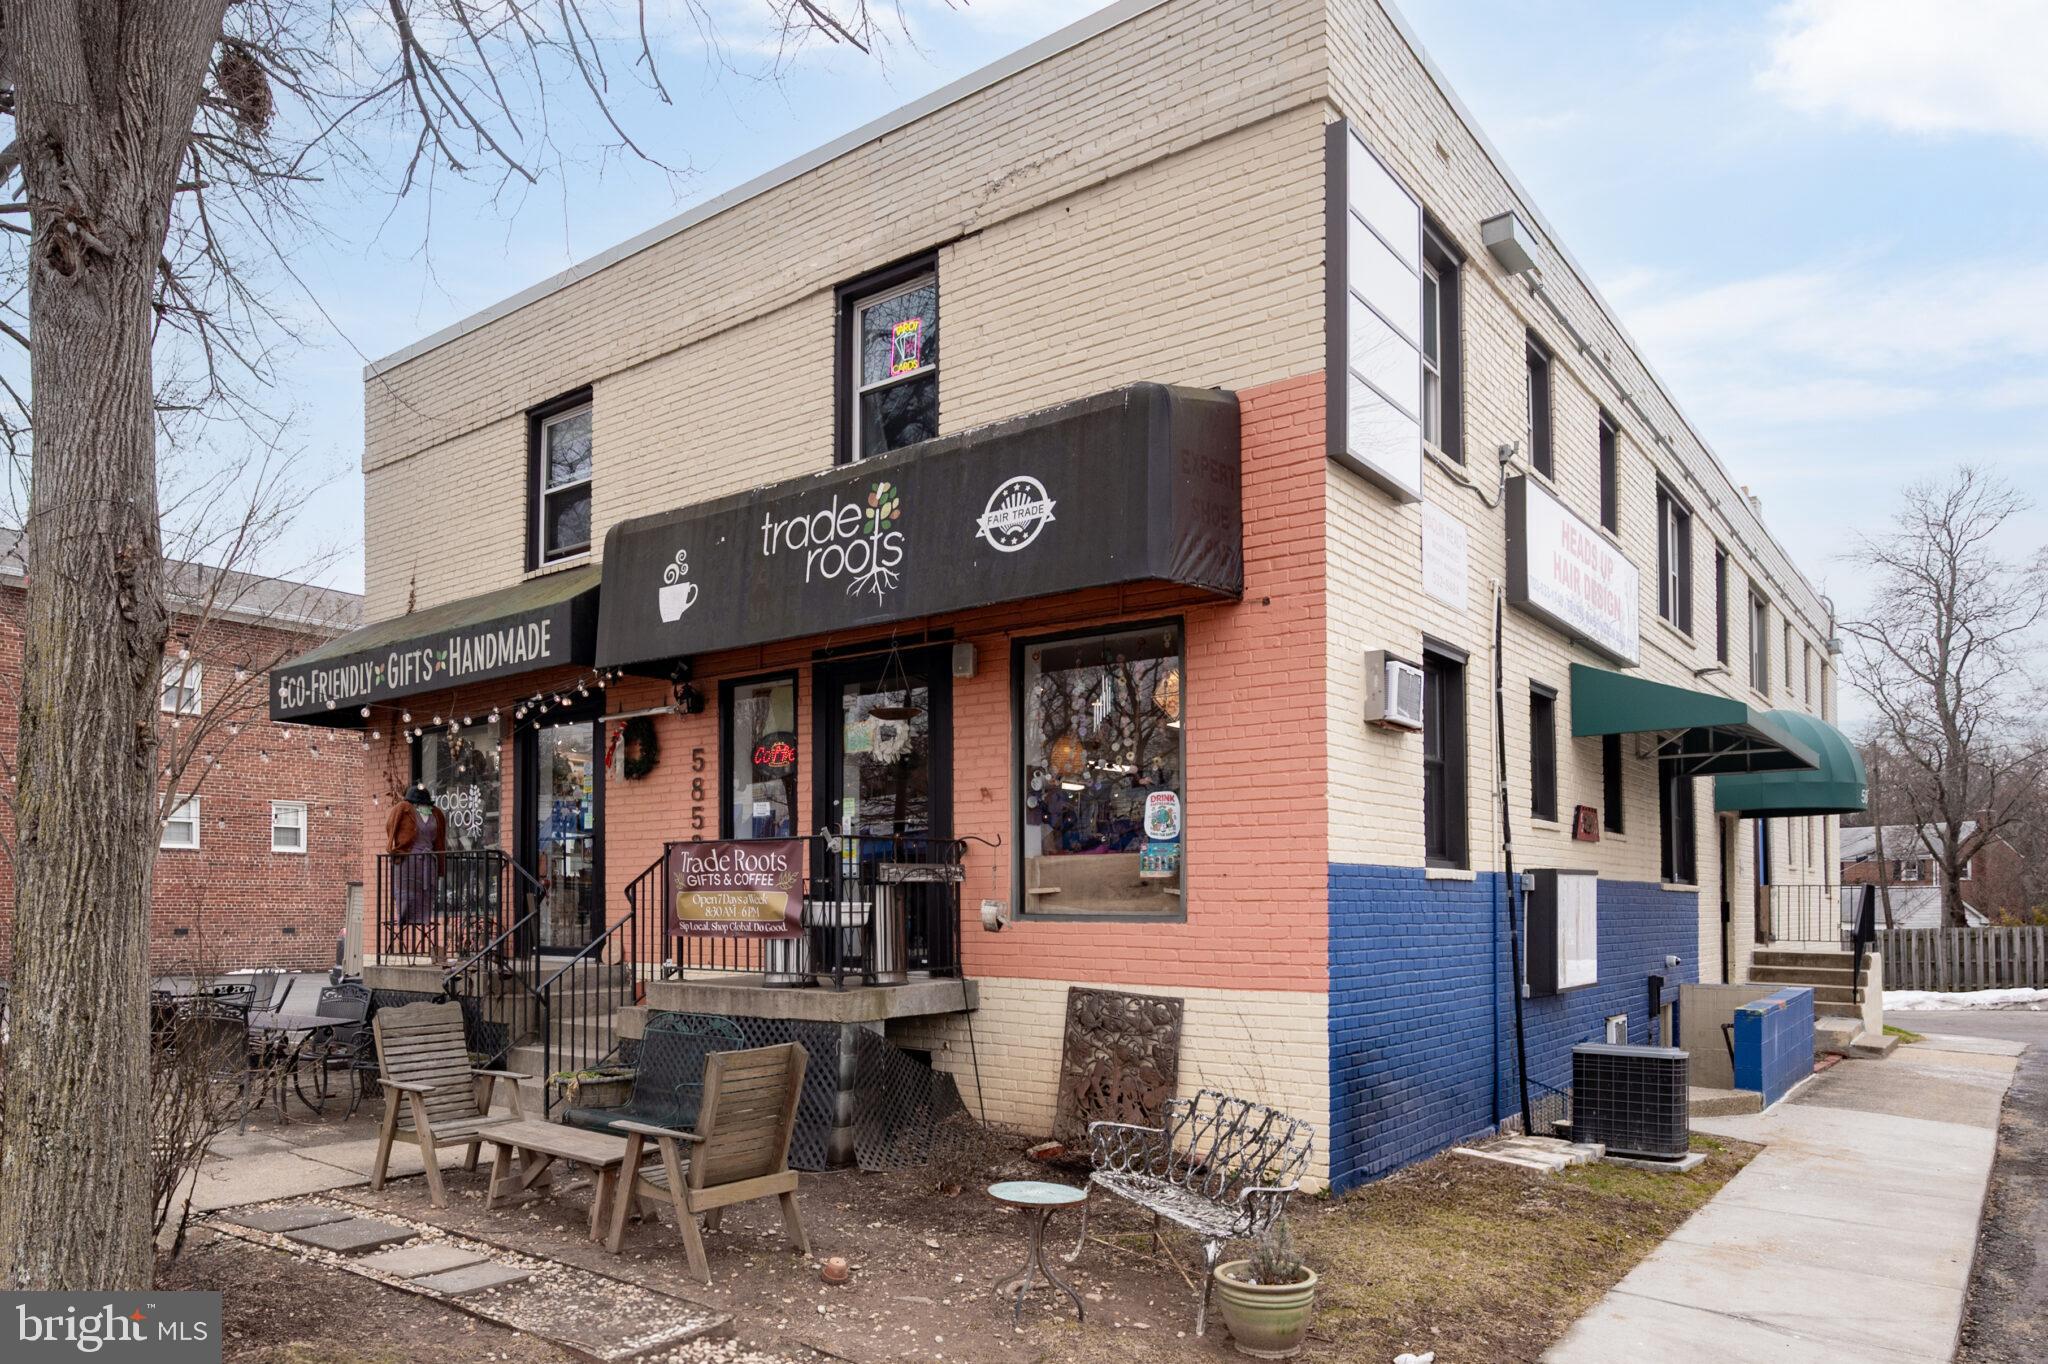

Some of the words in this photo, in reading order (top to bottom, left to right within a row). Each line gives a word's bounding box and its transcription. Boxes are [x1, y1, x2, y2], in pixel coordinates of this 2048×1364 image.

[895, 320, 918, 336] TAROT
[893, 360, 917, 373] CARDS
[1182, 449, 1235, 490] EXPERT
[761, 494, 862, 556] trade
[987, 511, 1010, 526] FAIR
[1012, 503, 1045, 519] TRADE
[1192, 498, 1231, 530] SHOE
[806, 508, 904, 583] roots
[1561, 519, 1598, 571] HEADS
[1600, 551, 1614, 582] UP
[1553, 552, 1581, 596] HAIR
[1583, 574, 1621, 622] DESIGN
[280, 661, 374, 710] ECO-FRIENDLY
[388, 648, 433, 689] GIFTS
[449, 619, 551, 677] HANDMADE
[1150, 794, 1175, 803] DRINK
[449, 797, 483, 827] roots
[681, 849, 731, 873] Trade
[734, 849, 788, 872] Roots
[687, 873, 720, 887] GIFTS
[723, 873, 732, 886] &
[734, 873, 774, 886] COFFEE
[692, 894, 717, 907] Open
[722, 894, 743, 907] Days
[748, 893, 768, 904] Week
[722, 906, 737, 917] AM
[741, 907, 747, 917] 6
[748, 906, 760, 917] PM
[680, 922, 689, 932] Sip
[711, 922, 729, 934] Shop
[754, 923, 764, 931] Do
